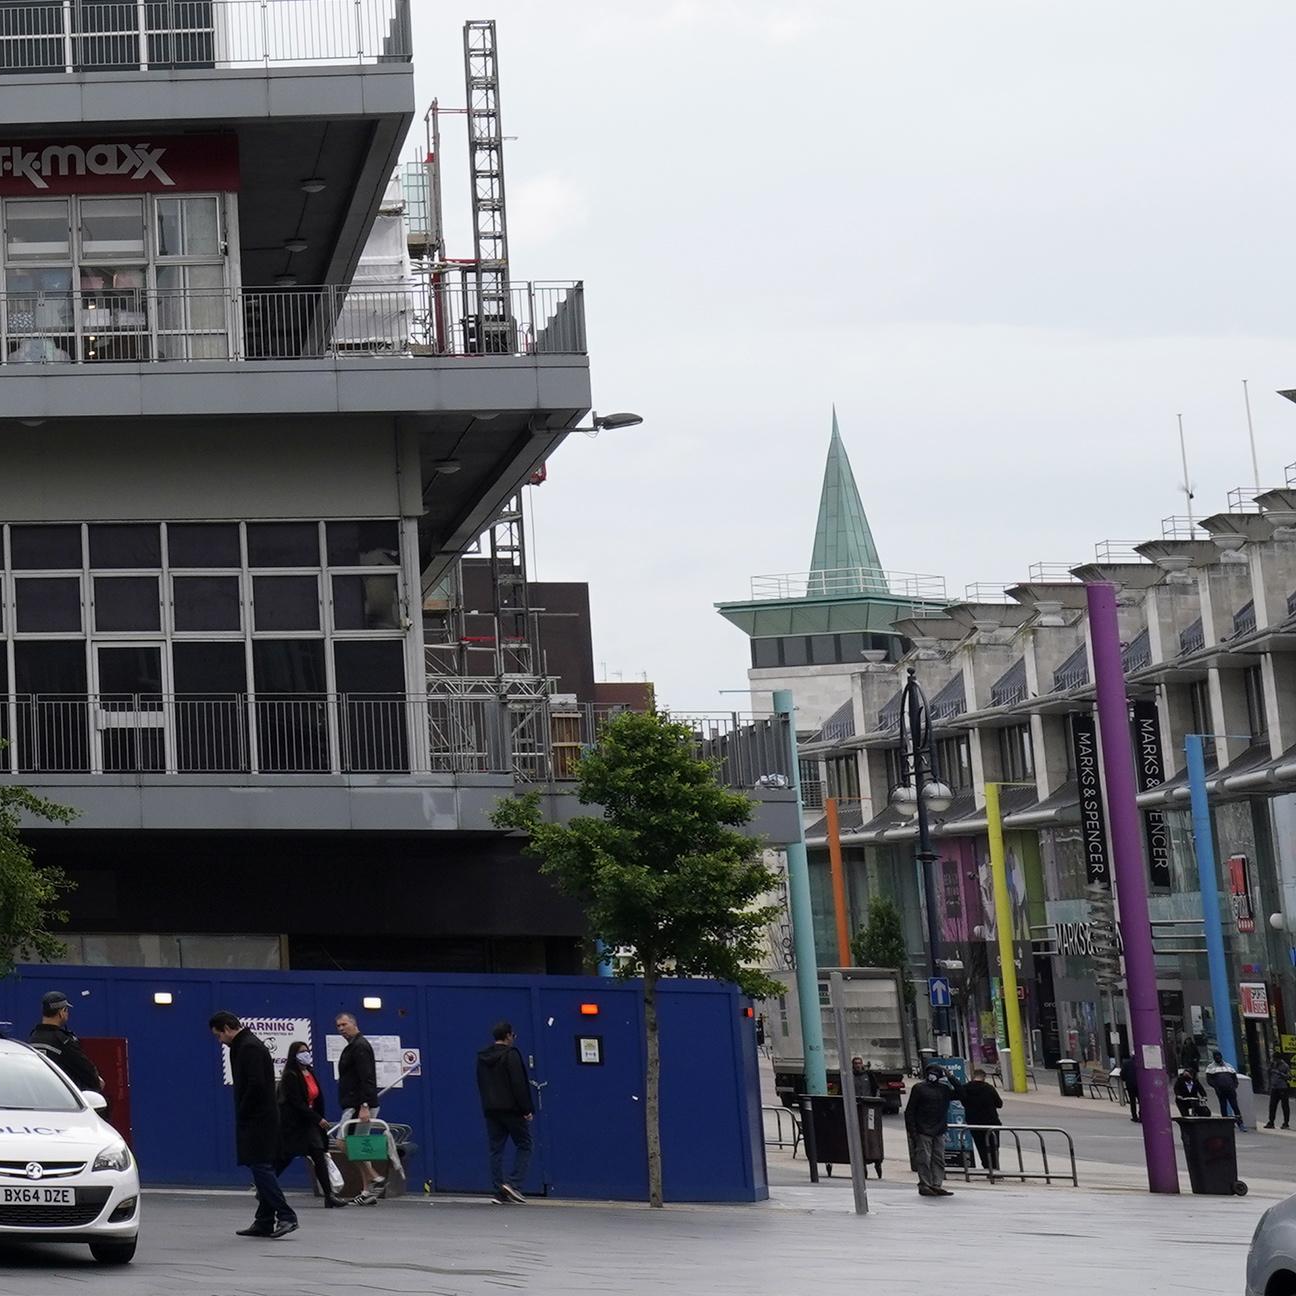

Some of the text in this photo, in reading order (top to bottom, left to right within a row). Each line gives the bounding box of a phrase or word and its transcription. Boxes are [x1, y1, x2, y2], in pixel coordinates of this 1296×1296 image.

[1140, 718, 1160, 775] MARKS
[1078, 732, 1104, 874] MARKS & SPENCER
[1149, 809, 1168, 869] ENCER
[1055, 923, 1086, 955] MARKS
[4, 1189, 70, 1203] BX64 DZE
